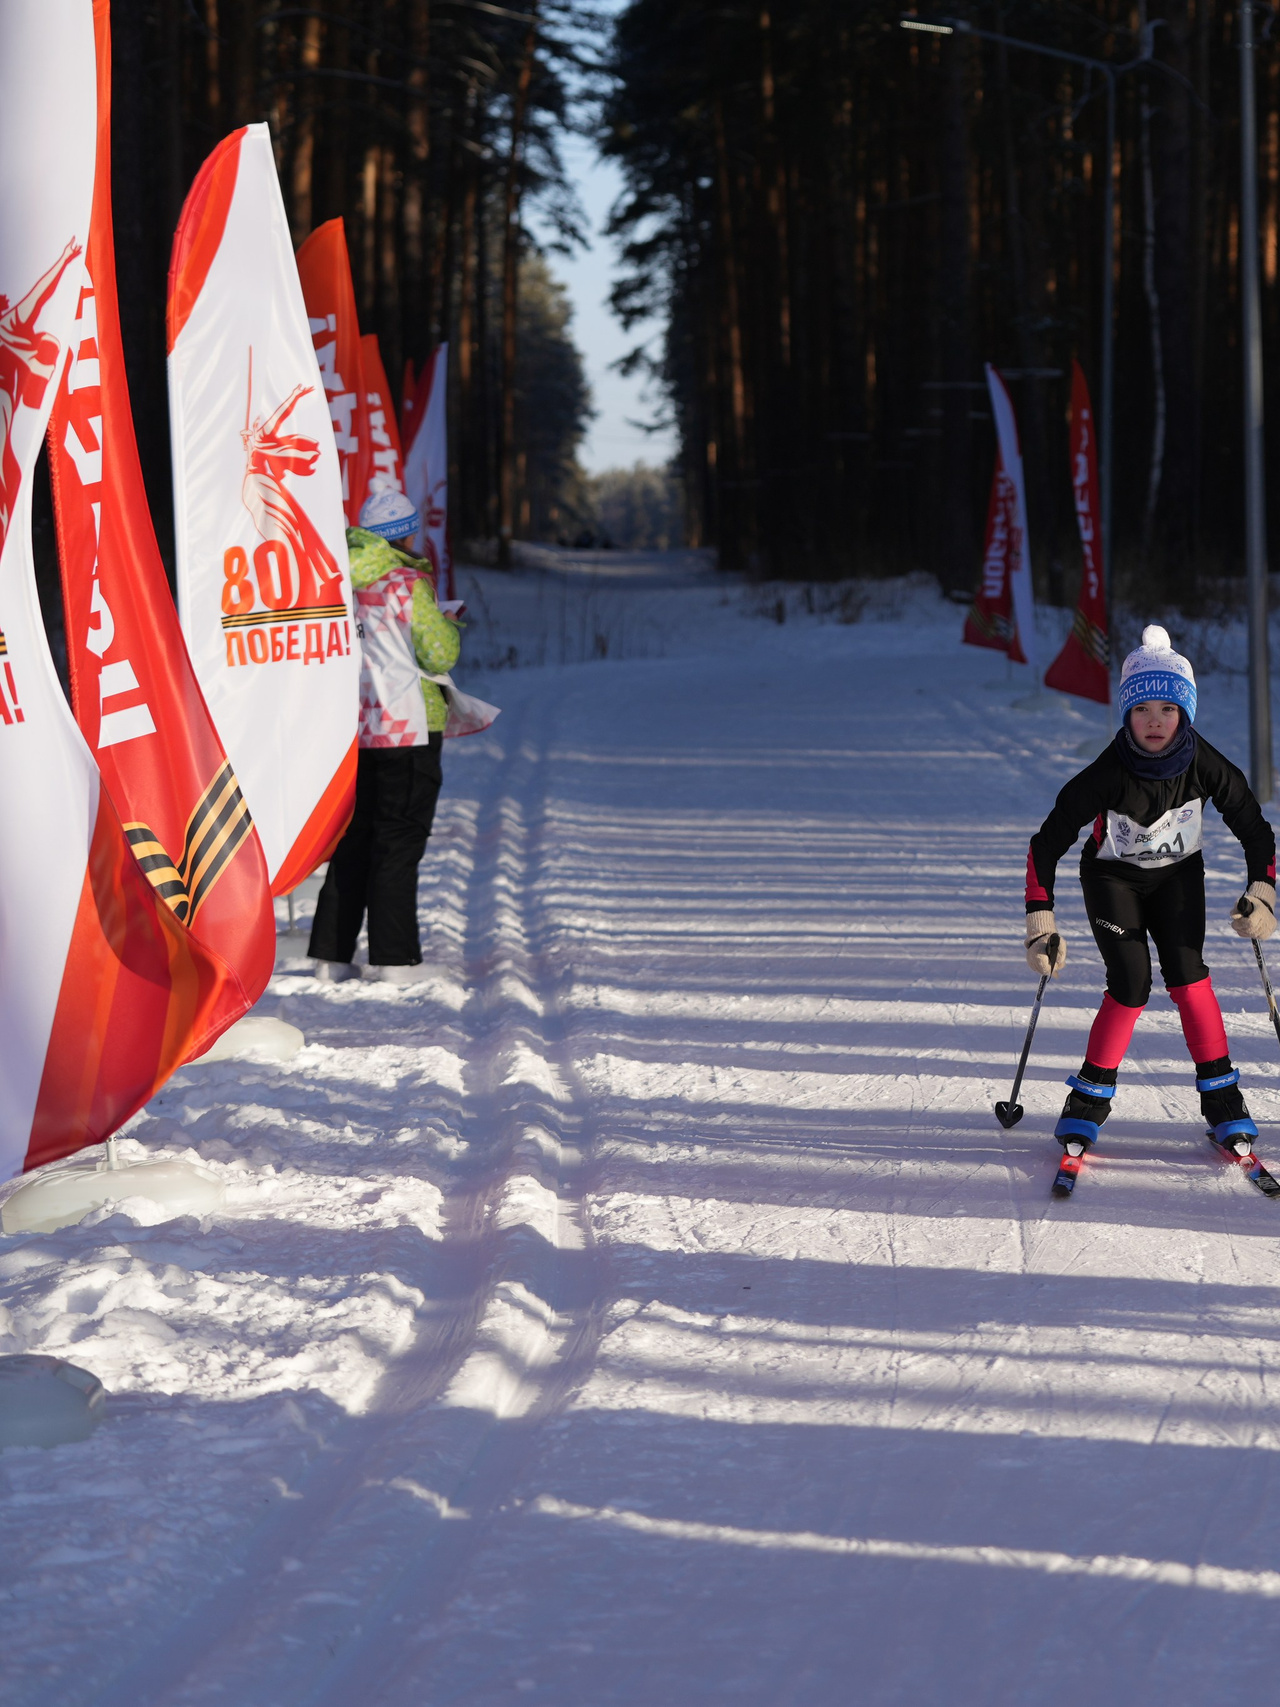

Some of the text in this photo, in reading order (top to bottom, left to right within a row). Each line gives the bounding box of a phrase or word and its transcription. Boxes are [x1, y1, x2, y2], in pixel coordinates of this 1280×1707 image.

[221, 539, 294, 616] 80
[224, 620, 351, 668] ПОБЕДА!
[1095, 917, 1125, 935] VITZHEN
